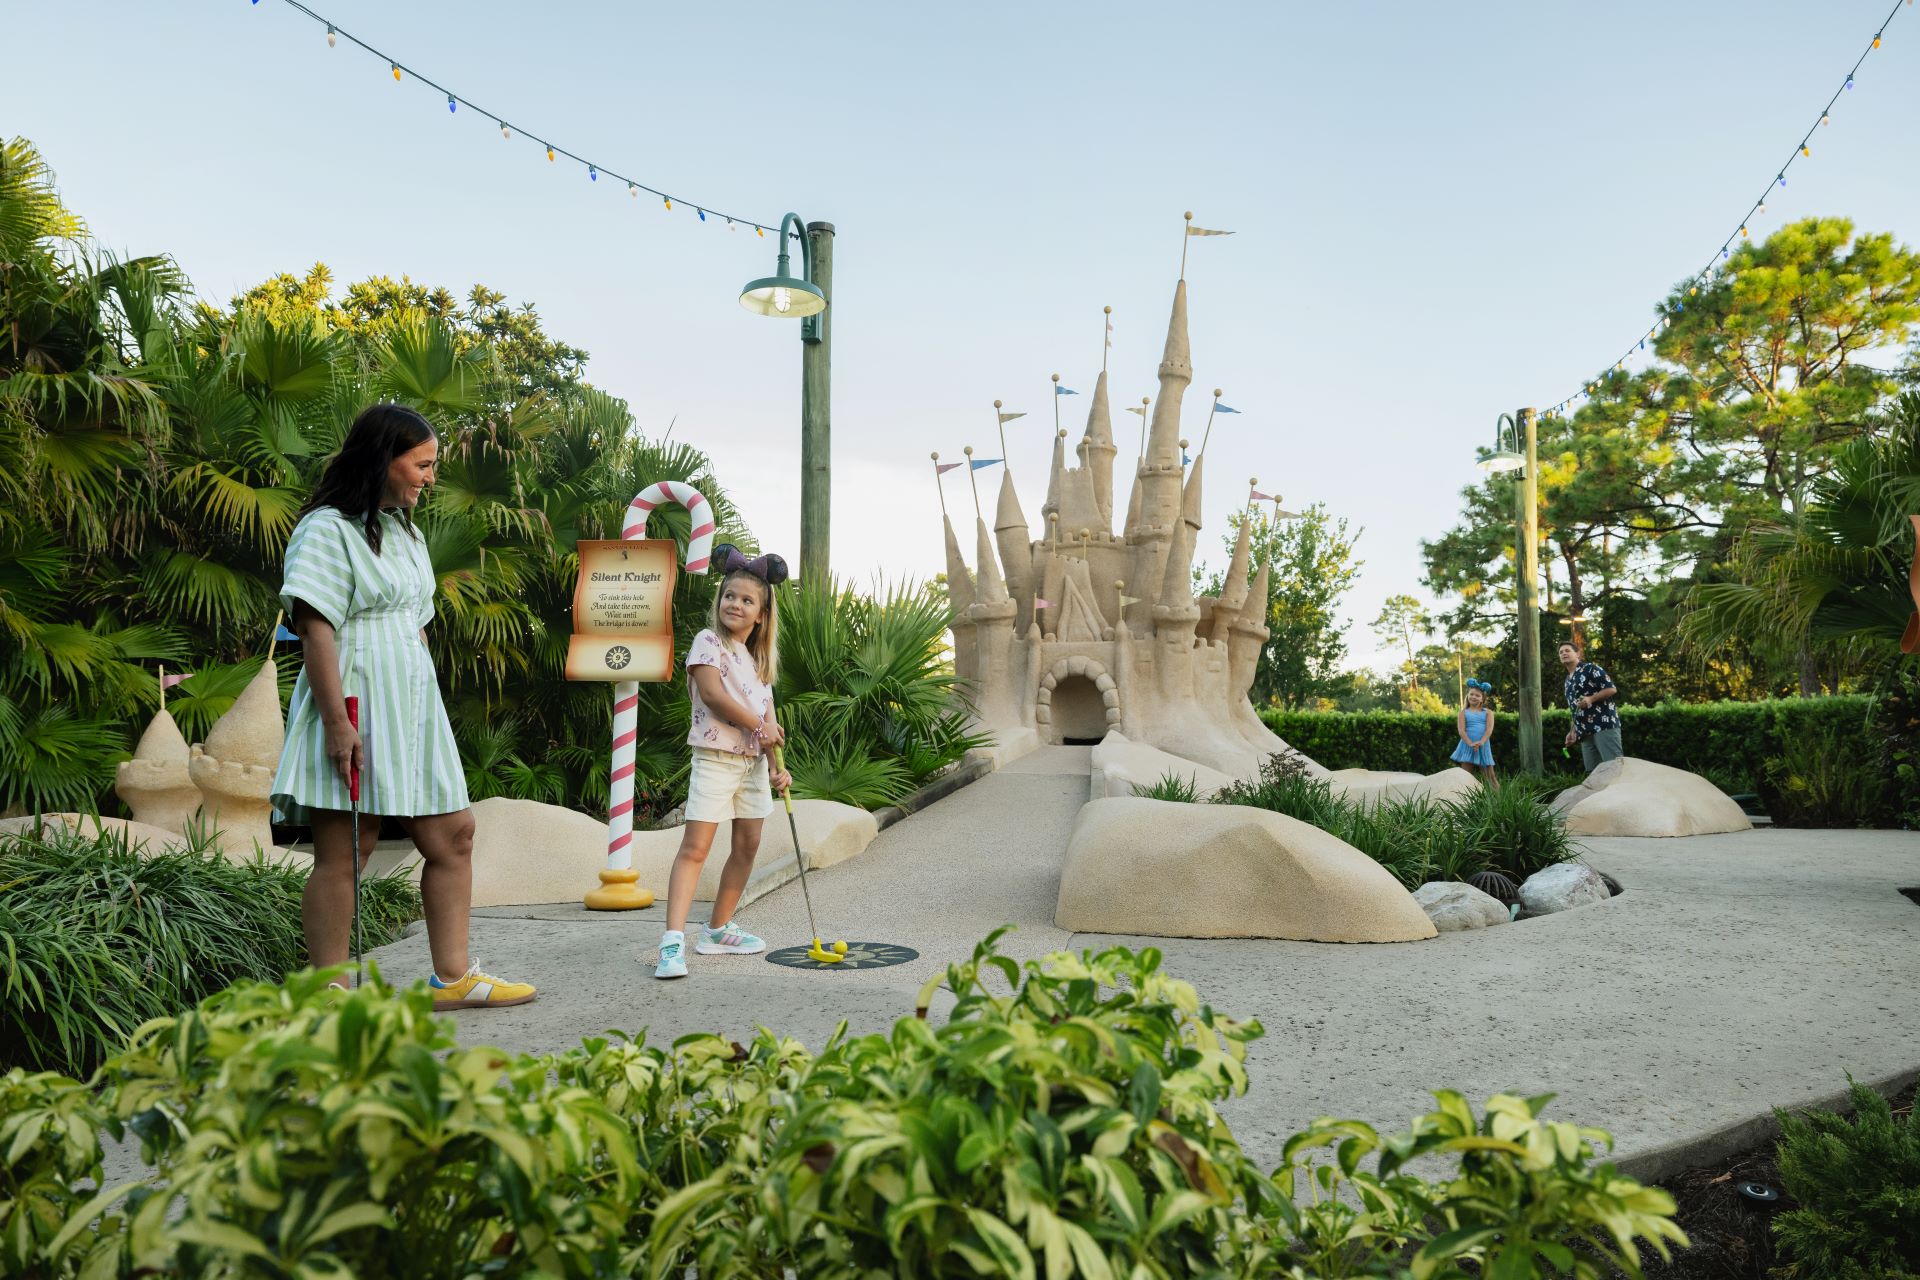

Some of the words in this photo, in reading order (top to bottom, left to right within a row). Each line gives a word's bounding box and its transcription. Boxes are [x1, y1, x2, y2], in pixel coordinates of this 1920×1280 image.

[591, 573, 621, 581] Silent
[624, 572, 661, 583] Knight
[591, 602, 606, 610] And
[606, 620, 624, 629] bridge
